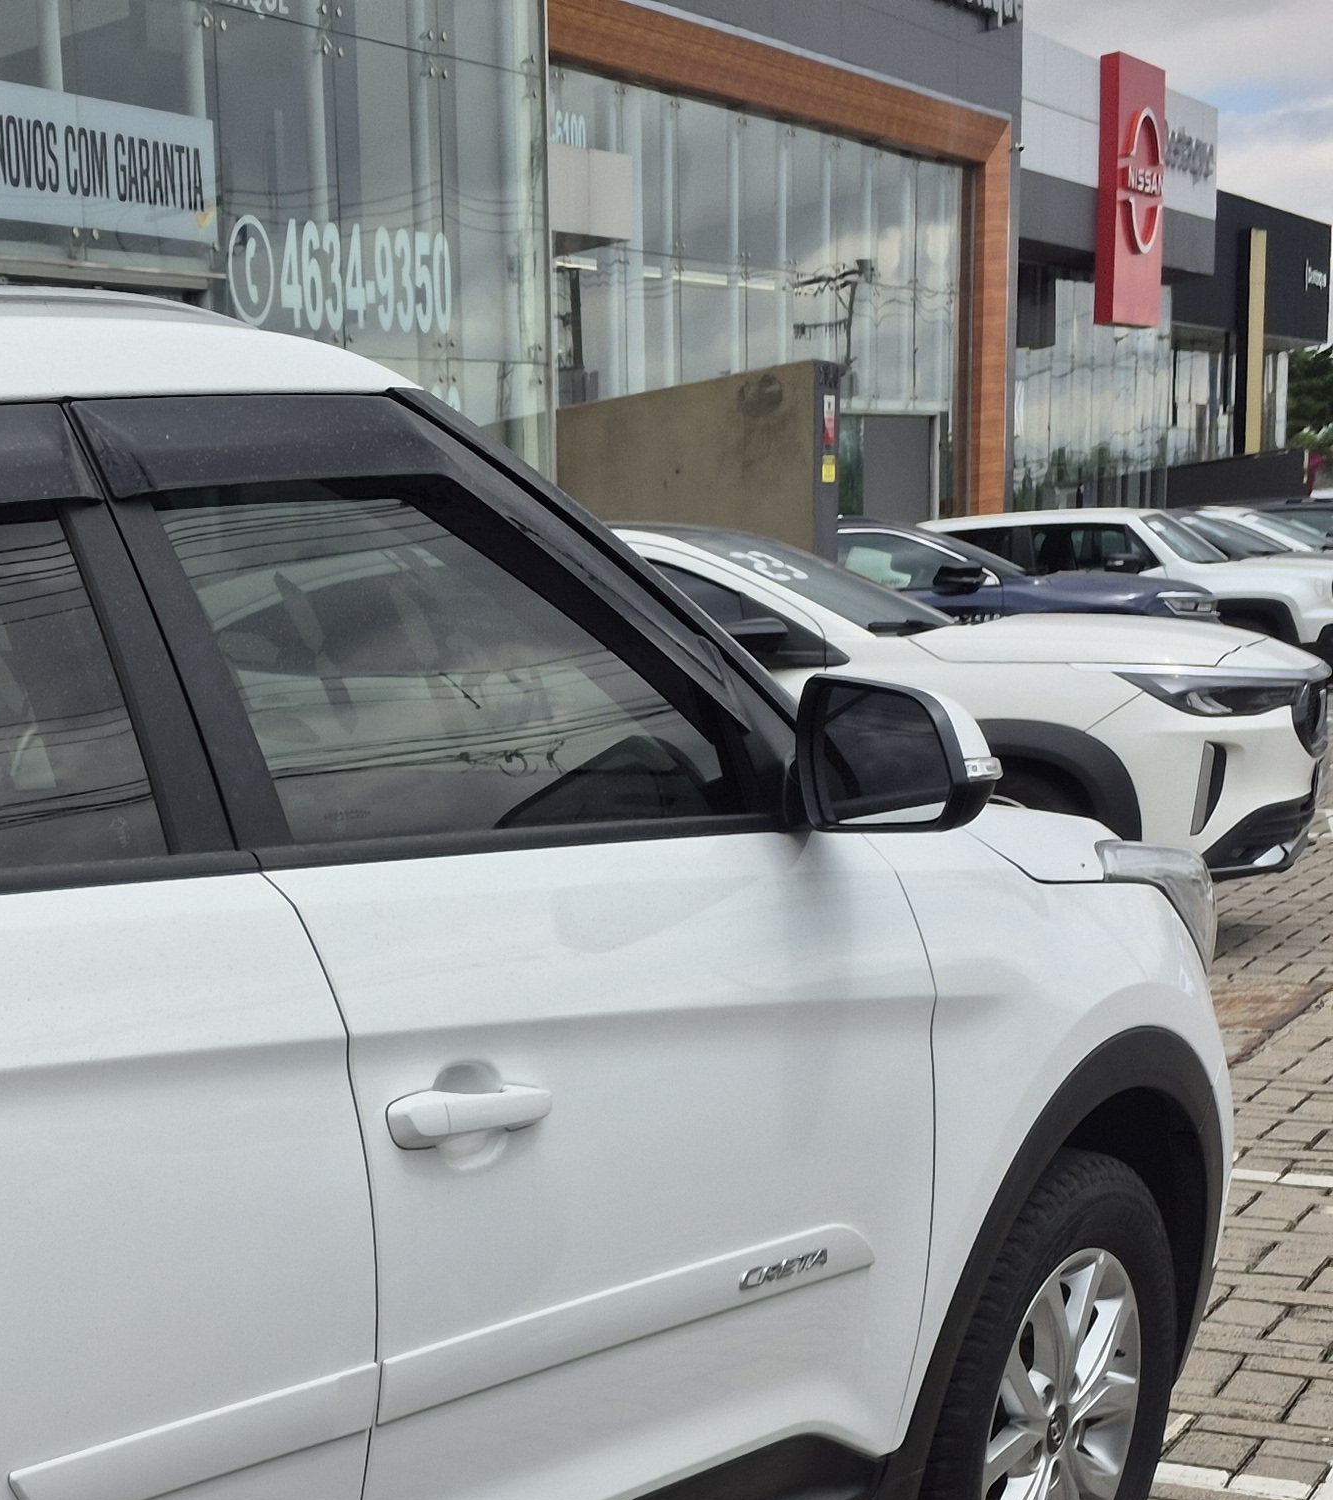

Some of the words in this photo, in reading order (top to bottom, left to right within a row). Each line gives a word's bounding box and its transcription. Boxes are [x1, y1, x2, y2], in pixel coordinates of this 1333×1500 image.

[64, 125, 110, 199] COM
[114, 133, 205, 212] GARANTIA
[1128, 165, 1164, 196] NISSAN
[281, 218, 453, 334] 4634-9350
[739, 1248, 828, 1292] CRETA
